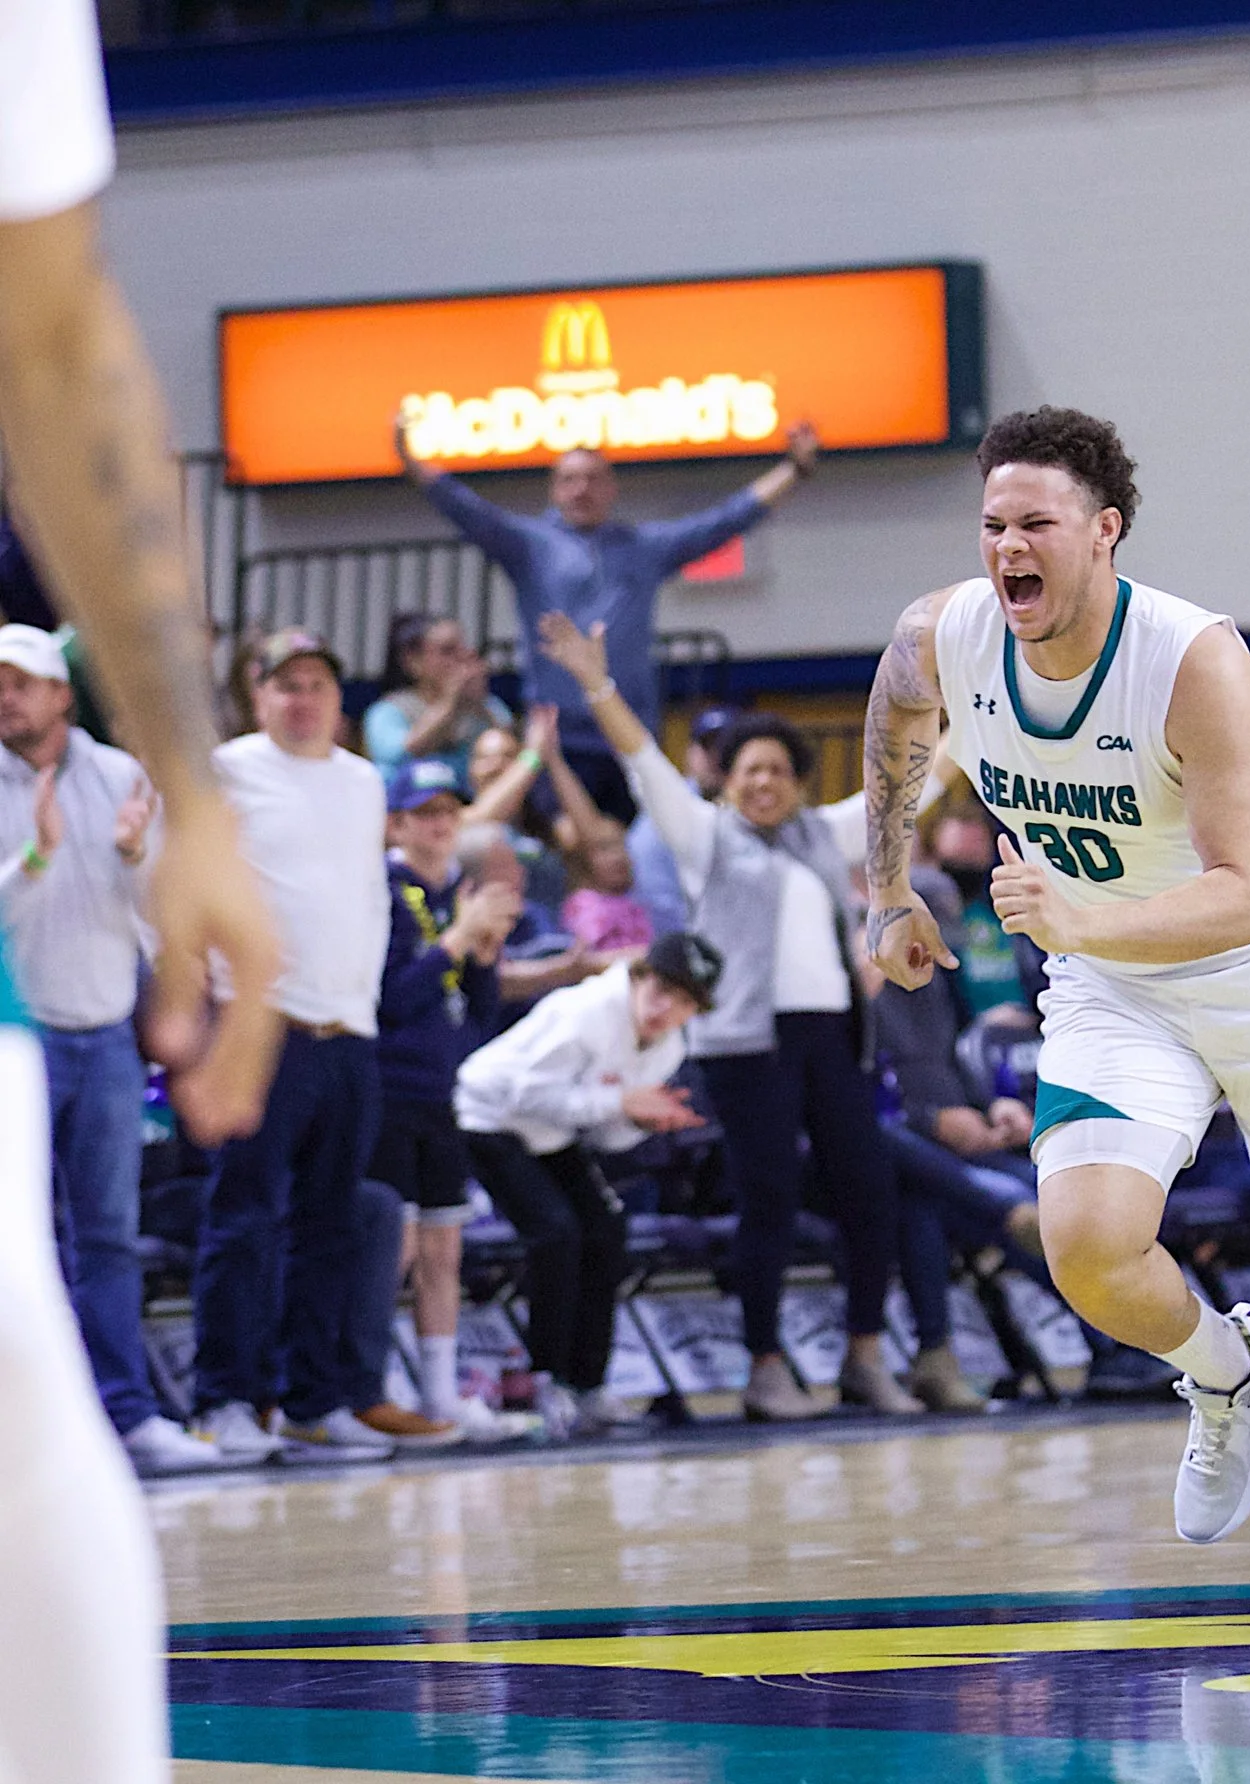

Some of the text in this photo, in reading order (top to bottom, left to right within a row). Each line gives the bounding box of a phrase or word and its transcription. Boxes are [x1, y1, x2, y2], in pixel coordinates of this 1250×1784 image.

[1096, 734, 1134, 753] CAA
[979, 757, 1143, 827] SEAHAWKS
[1024, 821, 1125, 883] 30
